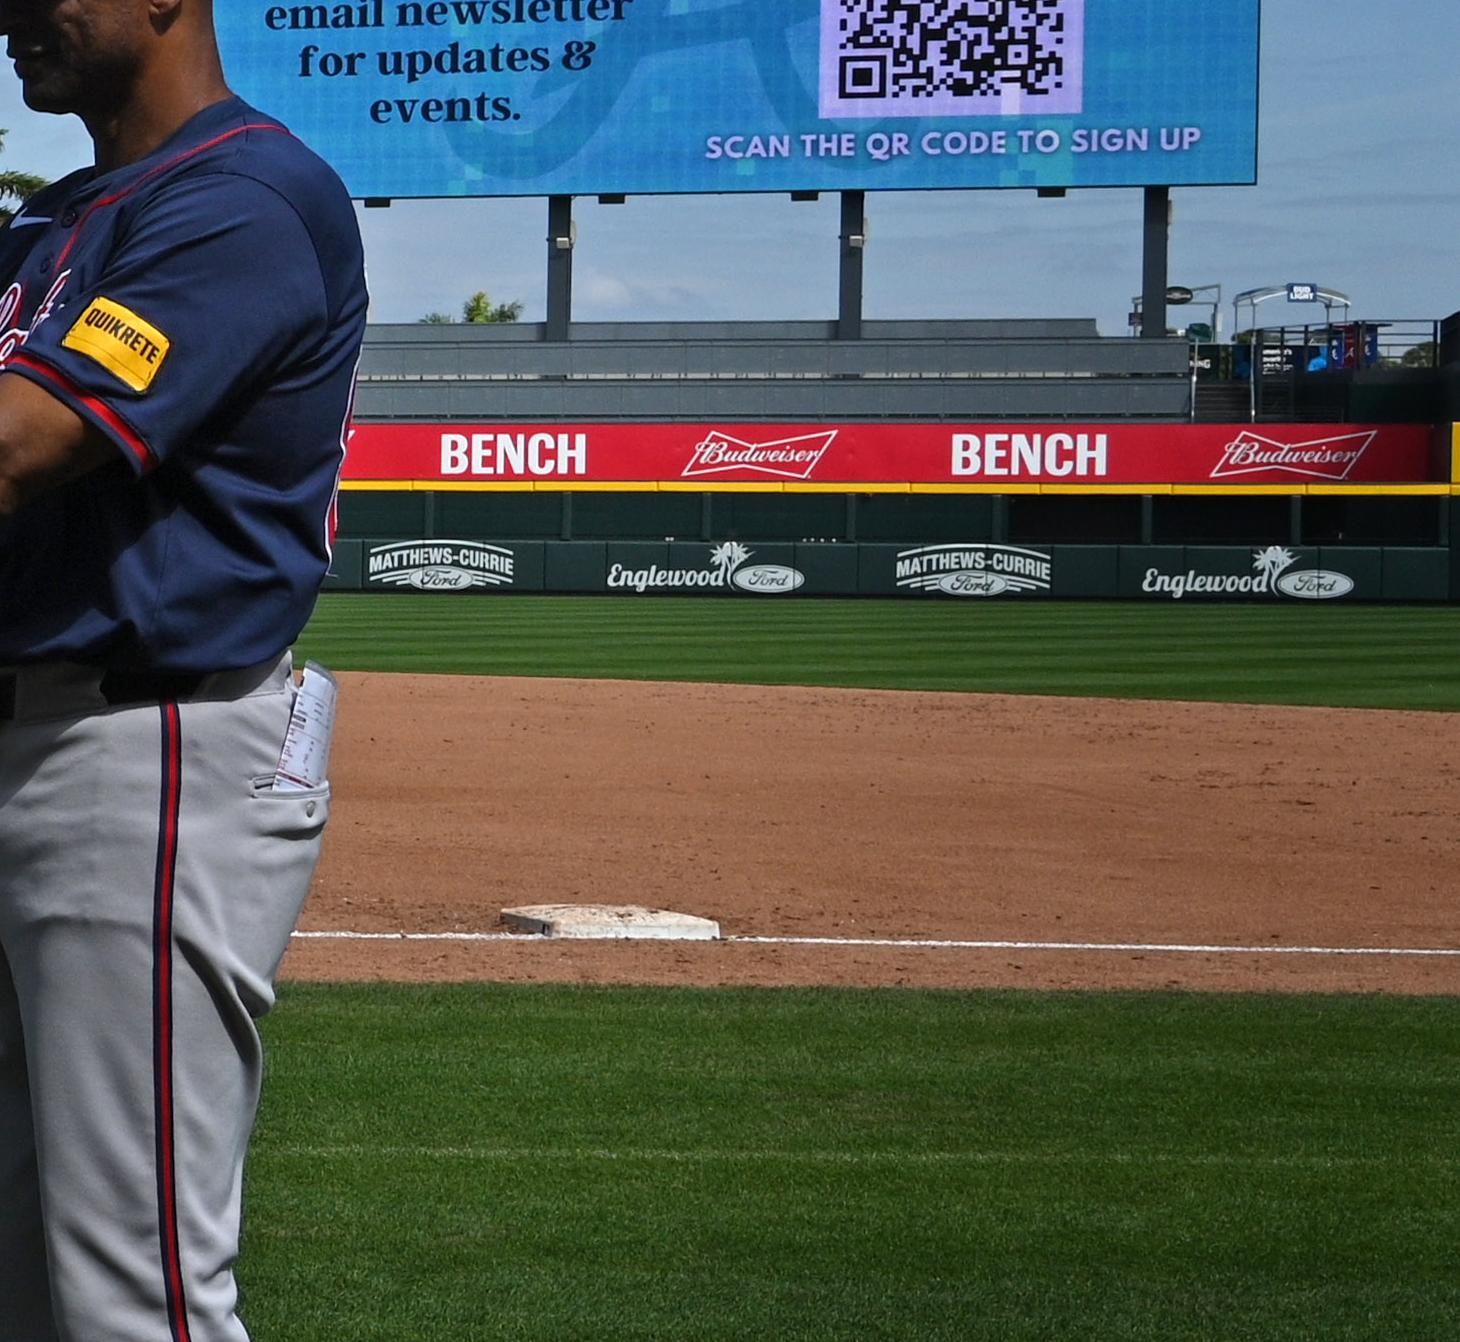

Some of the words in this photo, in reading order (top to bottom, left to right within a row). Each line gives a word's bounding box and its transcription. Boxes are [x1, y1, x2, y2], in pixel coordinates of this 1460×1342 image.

[298, 45, 366, 77] for
[376, 41, 551, 83] updates
[561, 40, 597, 71] &
[369, 92, 521, 124] events.
[705, 135, 790, 159] SCAN
[800, 133, 855, 157] THE
[866, 132, 911, 161] QR
[921, 130, 1006, 156] CODE
[1017, 129, 1060, 154] TO
[1070, 128, 1149, 153] SIGN
[1160, 127, 1202, 151] UP
[1293, 285, 1311, 293] BUD
[84, 307, 160, 364] QUIKRETE
[441, 433, 586, 475] BENCH
[695, 442, 820, 465] Budweiser
[951, 433, 1107, 476] BENCH
[1225, 441, 1362, 466] Budweiser
[369, 548, 514, 575] MATTHEWS-CURRIE
[896, 550, 1051, 579] MATTHEWS-CURRIE
[419, 567, 473, 588] Ford
[607, 563, 725, 592] Englewood
[747, 570, 792, 588] Ford
[949, 573, 996, 593] Ford
[1142, 567, 1269, 598] Englewood
[1294, 573, 1339, 593] Ford
